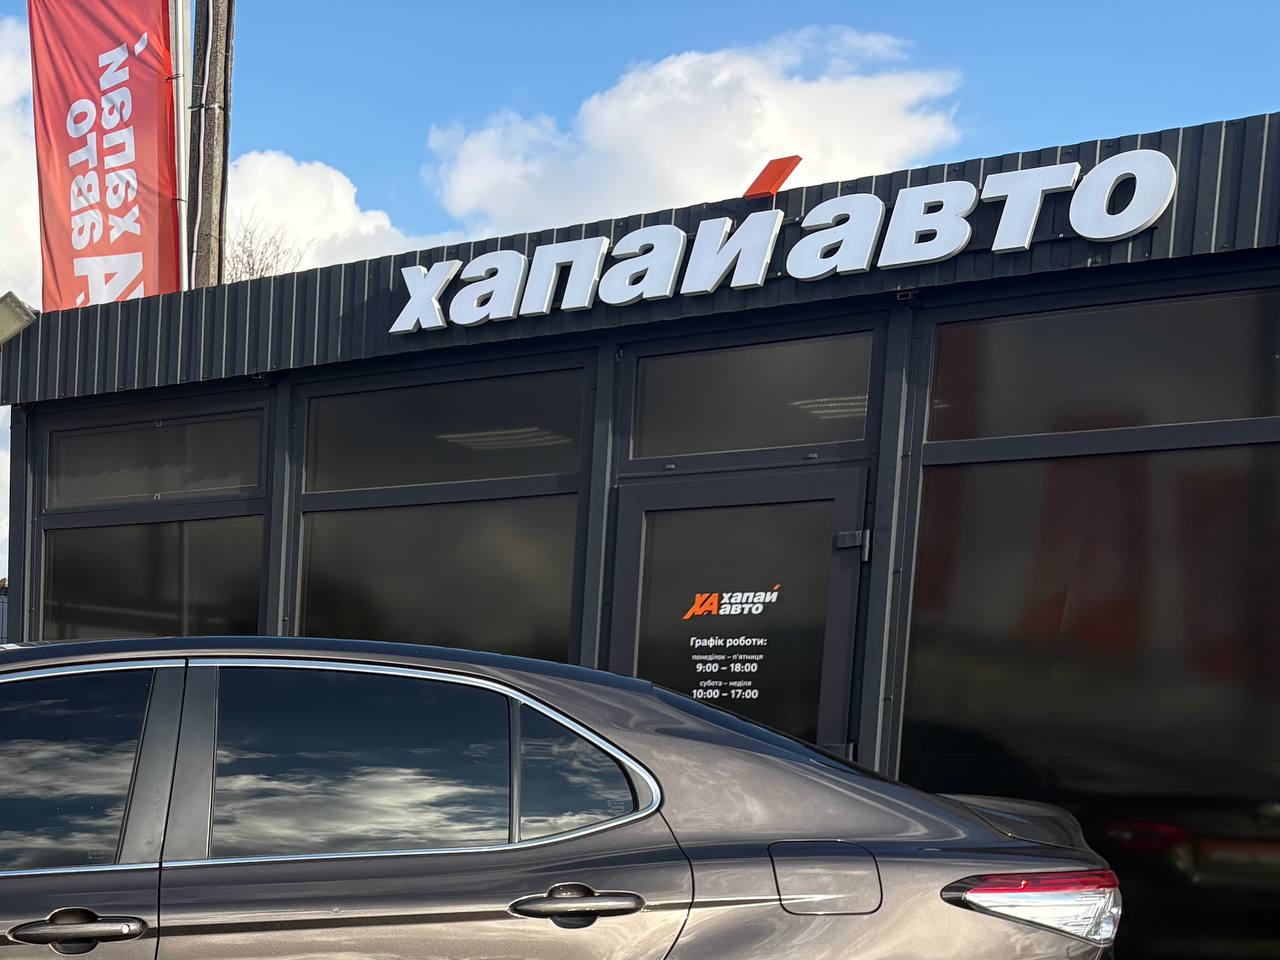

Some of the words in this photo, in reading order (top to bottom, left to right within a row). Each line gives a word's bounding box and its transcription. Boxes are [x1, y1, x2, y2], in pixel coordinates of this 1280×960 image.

[719, 603, 764, 615] авто
[690, 636, 725, 648] Графік
[726, 636, 768, 648] роботи:
[696, 662, 719, 672] 9:00
[729, 662, 758, 672] 18:00
[692, 689, 720, 699] 10:00
[730, 689, 759, 699] 17:00
